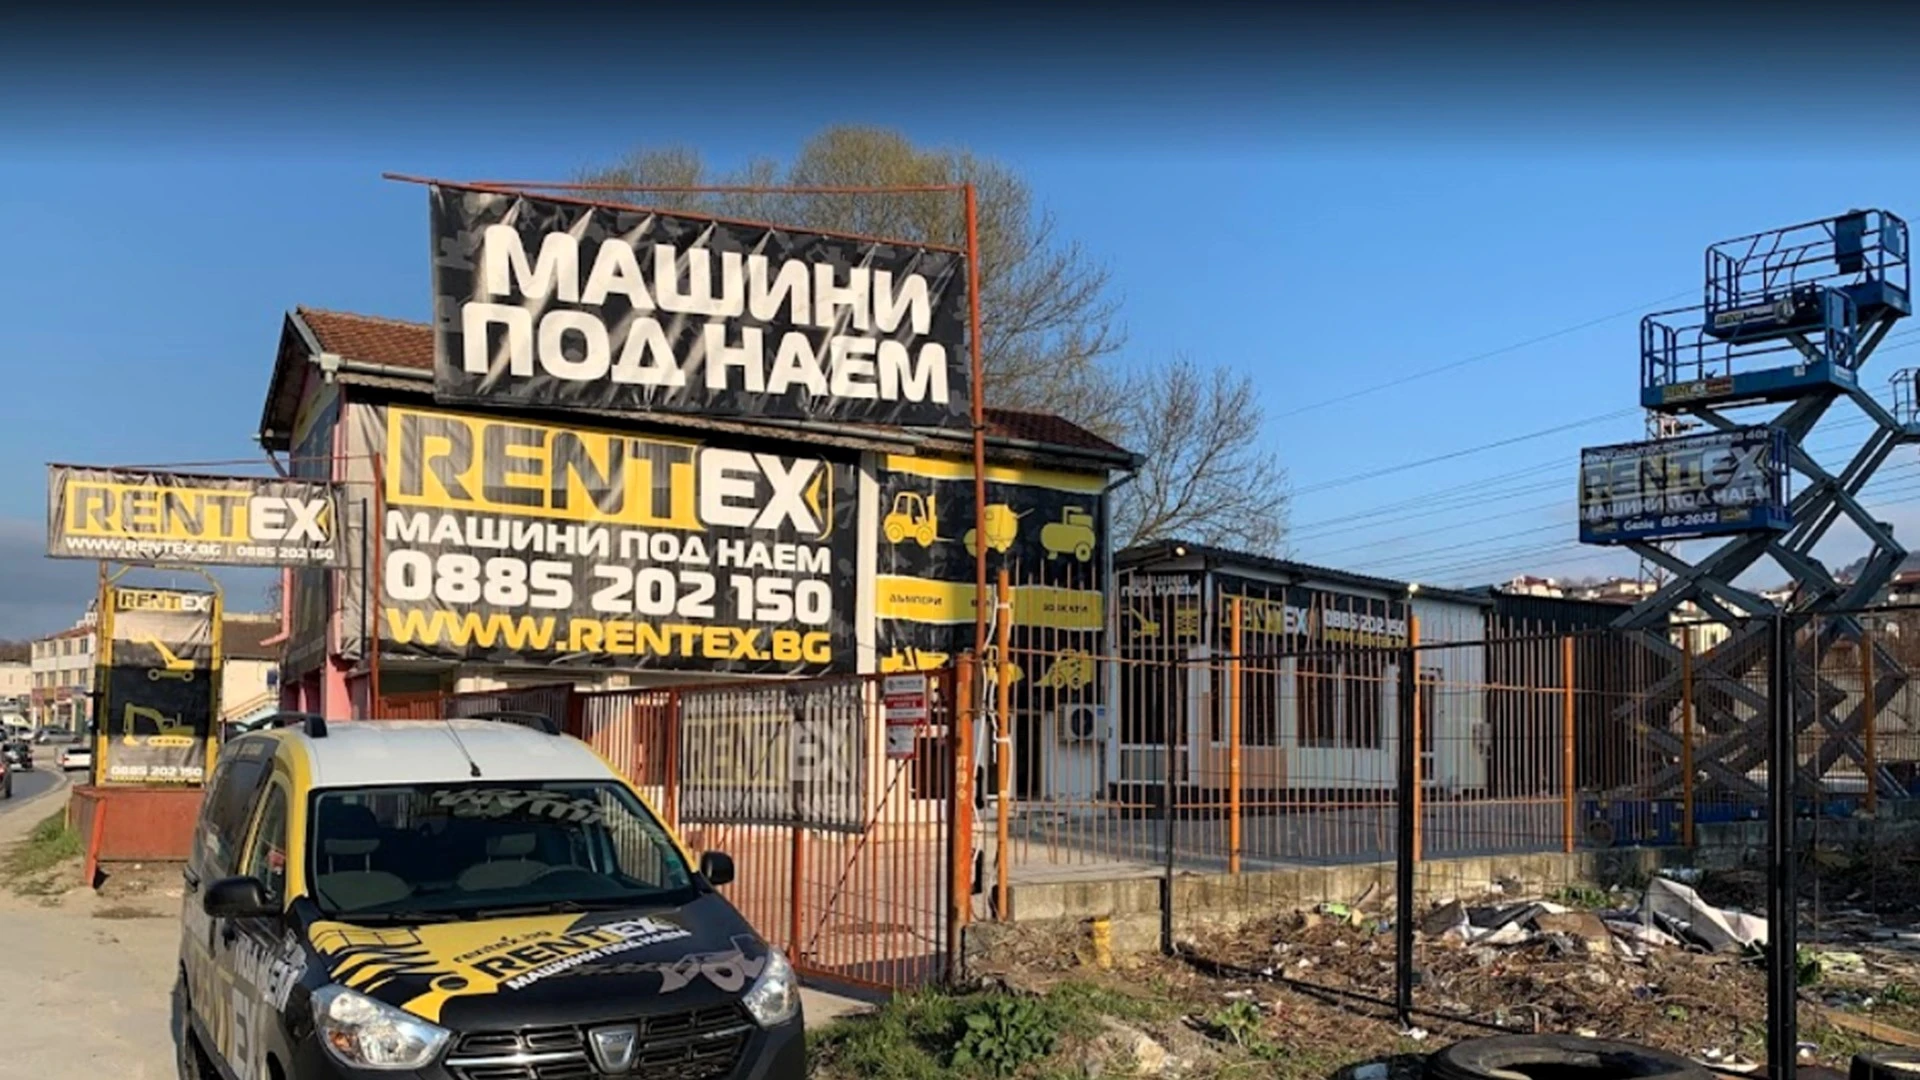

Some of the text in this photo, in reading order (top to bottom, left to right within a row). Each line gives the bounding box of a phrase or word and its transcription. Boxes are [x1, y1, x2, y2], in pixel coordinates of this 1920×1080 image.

[483, 223, 931, 335] МАШИНИ
[462, 302, 949, 404] ПОД НАЕМ
[389, 408, 831, 537] RENTEX
[69, 483, 331, 543] RENTEX
[1582, 486, 1770, 522] МАШИНИ ПОД НАЕМ
[237, 545, 335, 560] 0885 202 150
[386, 510, 831, 575] МАШИНИ ПОД НАЕМ
[386, 549, 831, 625] 0885 202 150
[386, 607, 831, 664] WWW.RENTEX.BG
[150, 766, 178, 777] 202
[180, 767, 203, 777] 150
